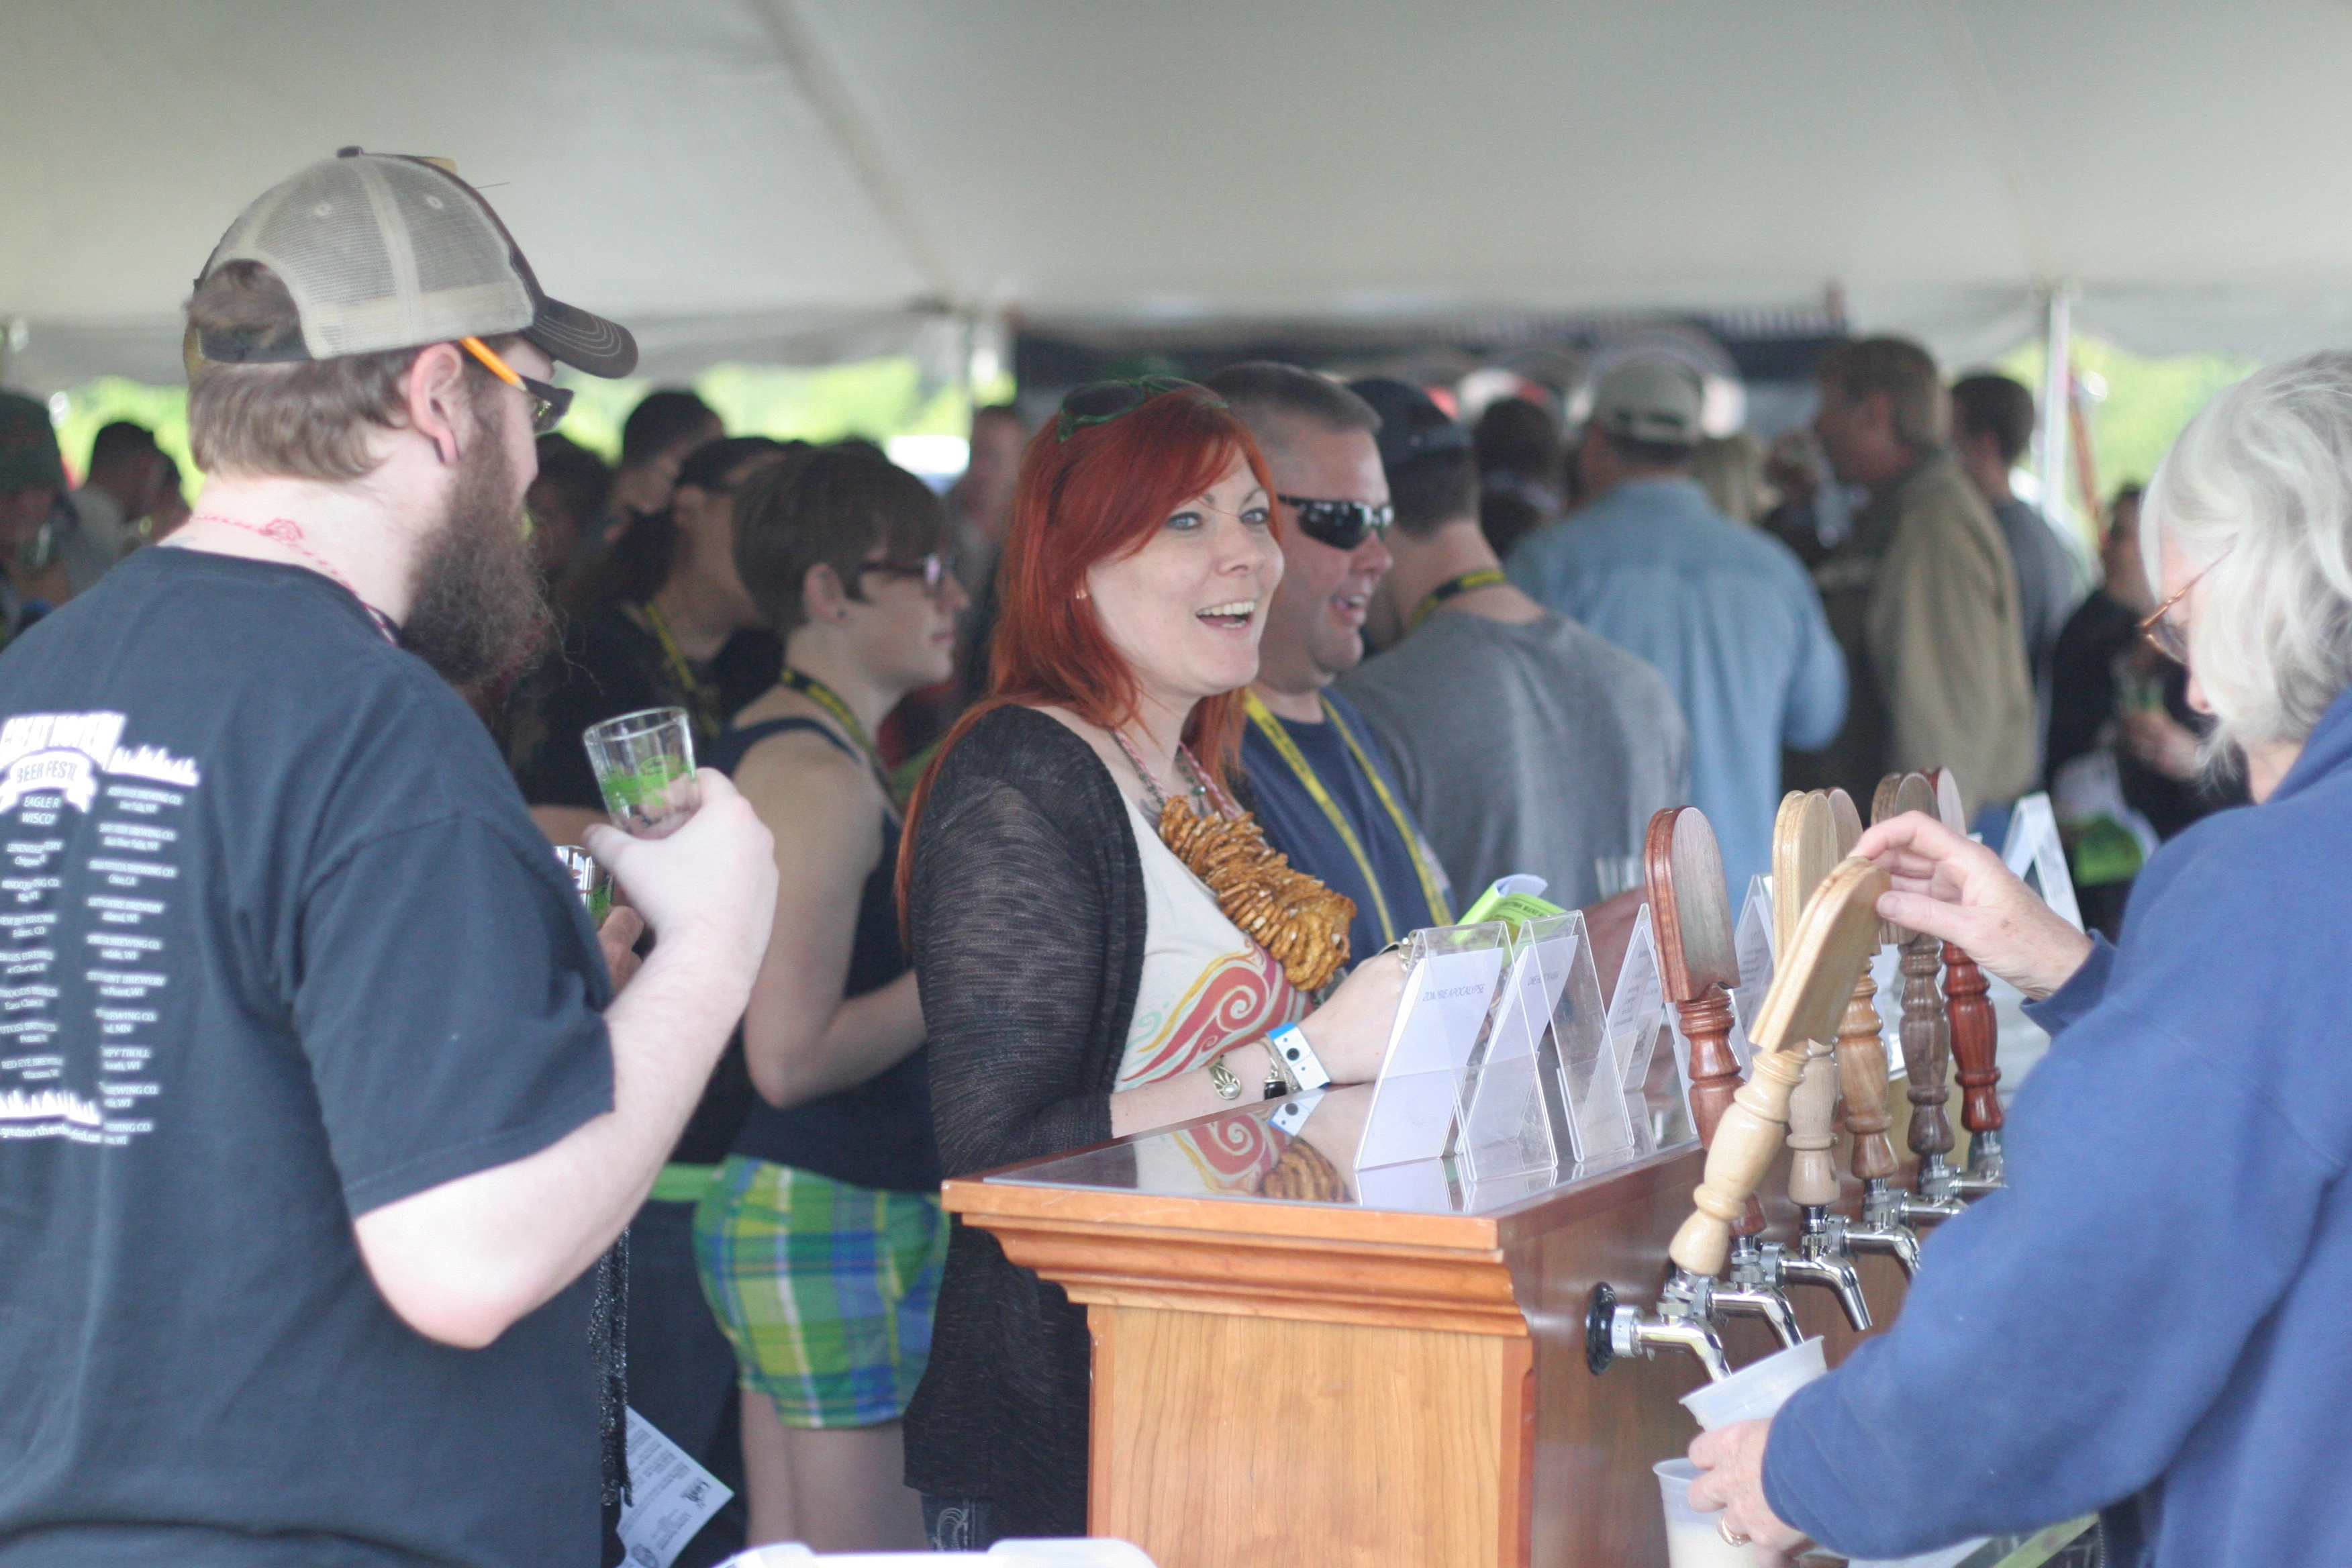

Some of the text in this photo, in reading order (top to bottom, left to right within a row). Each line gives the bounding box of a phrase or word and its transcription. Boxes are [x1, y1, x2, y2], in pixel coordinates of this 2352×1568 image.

[16, 764, 44, 784] BEER
[23, 795, 52, 808] EAGLE
[1422, 983, 1485, 1002] ZOMBIE APOCALYPSE
